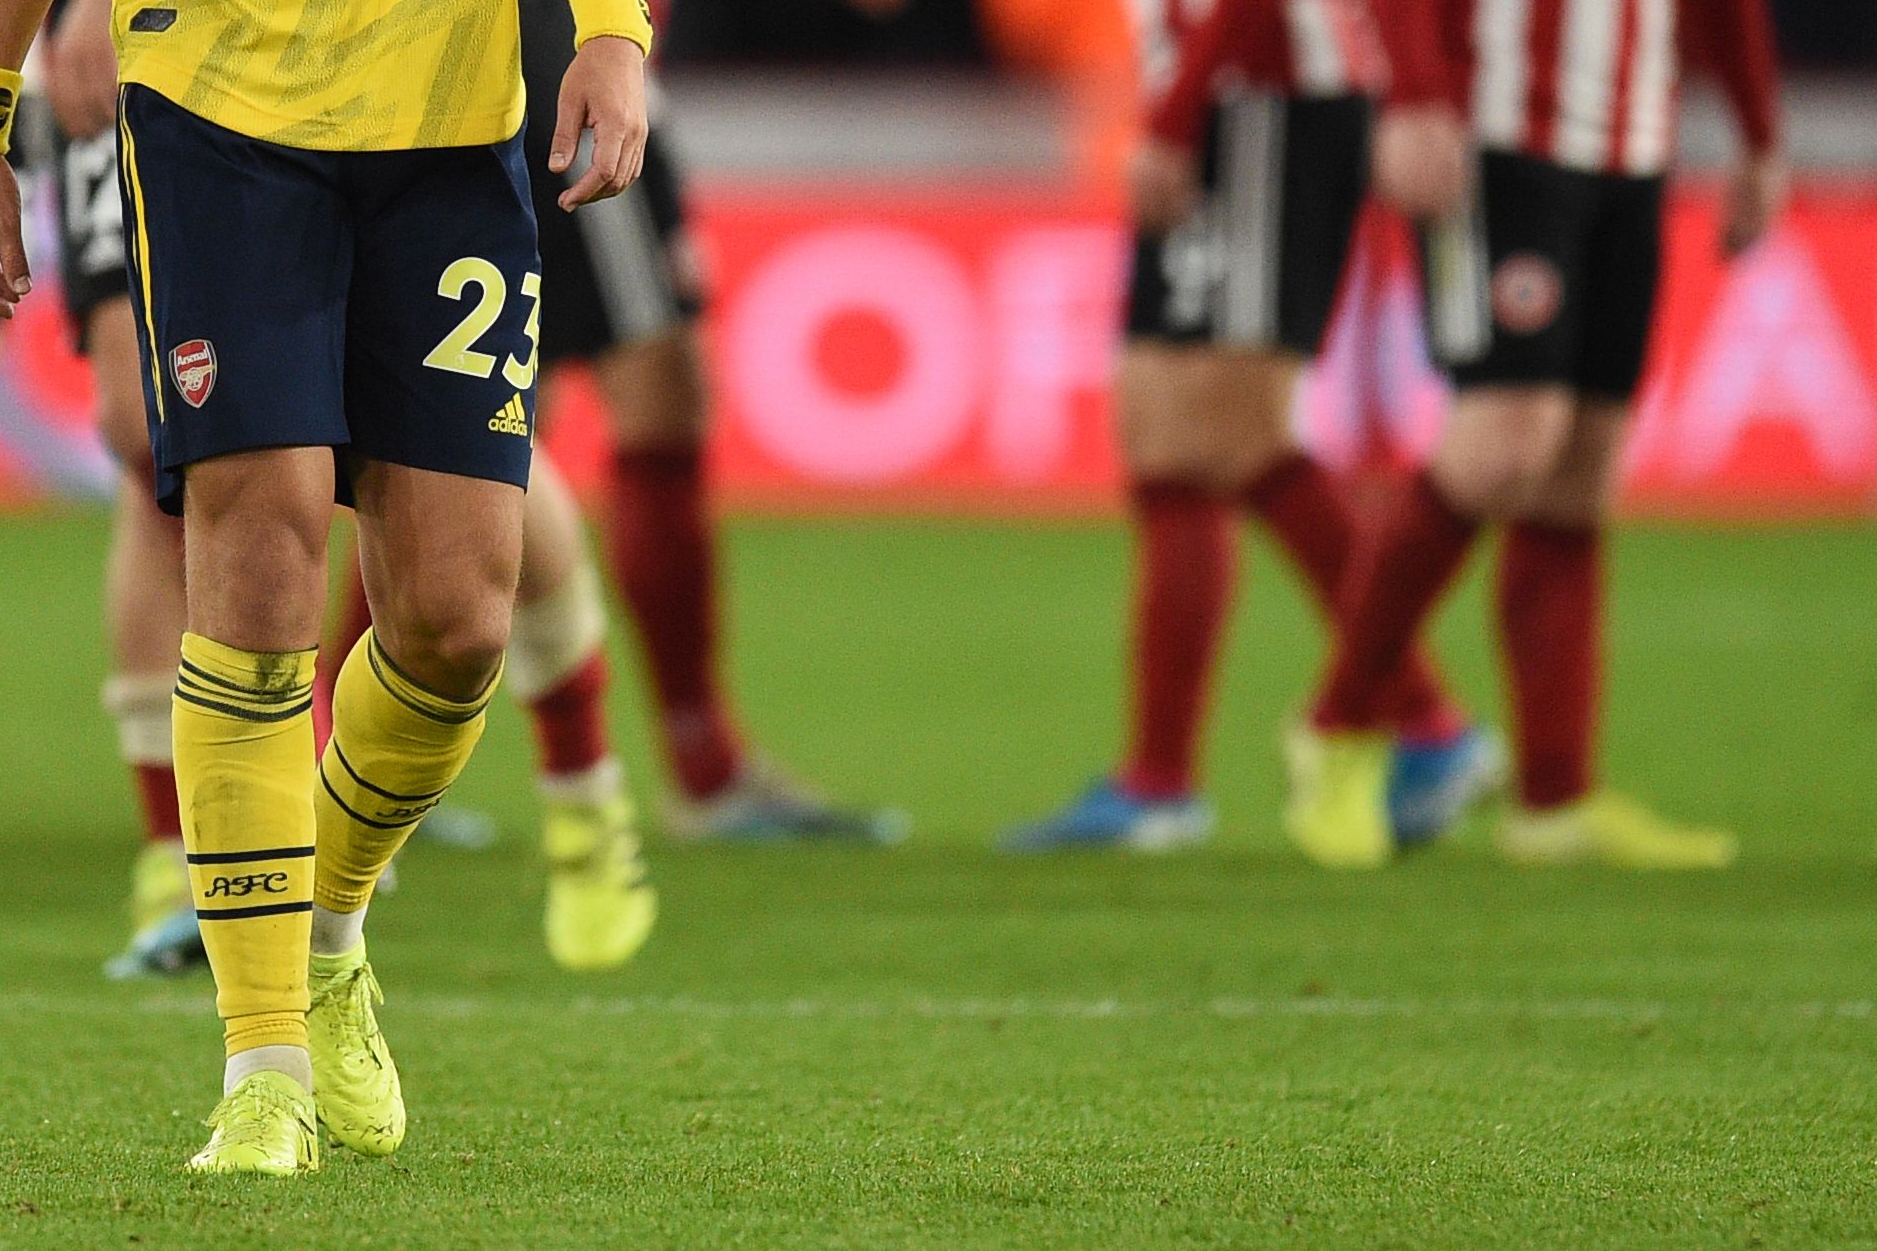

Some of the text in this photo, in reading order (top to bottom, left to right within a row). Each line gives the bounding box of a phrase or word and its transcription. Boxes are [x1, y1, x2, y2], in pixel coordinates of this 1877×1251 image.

[423, 256, 542, 390] 23
[488, 417, 527, 437] adidas
[204, 872, 288, 898] AFC
